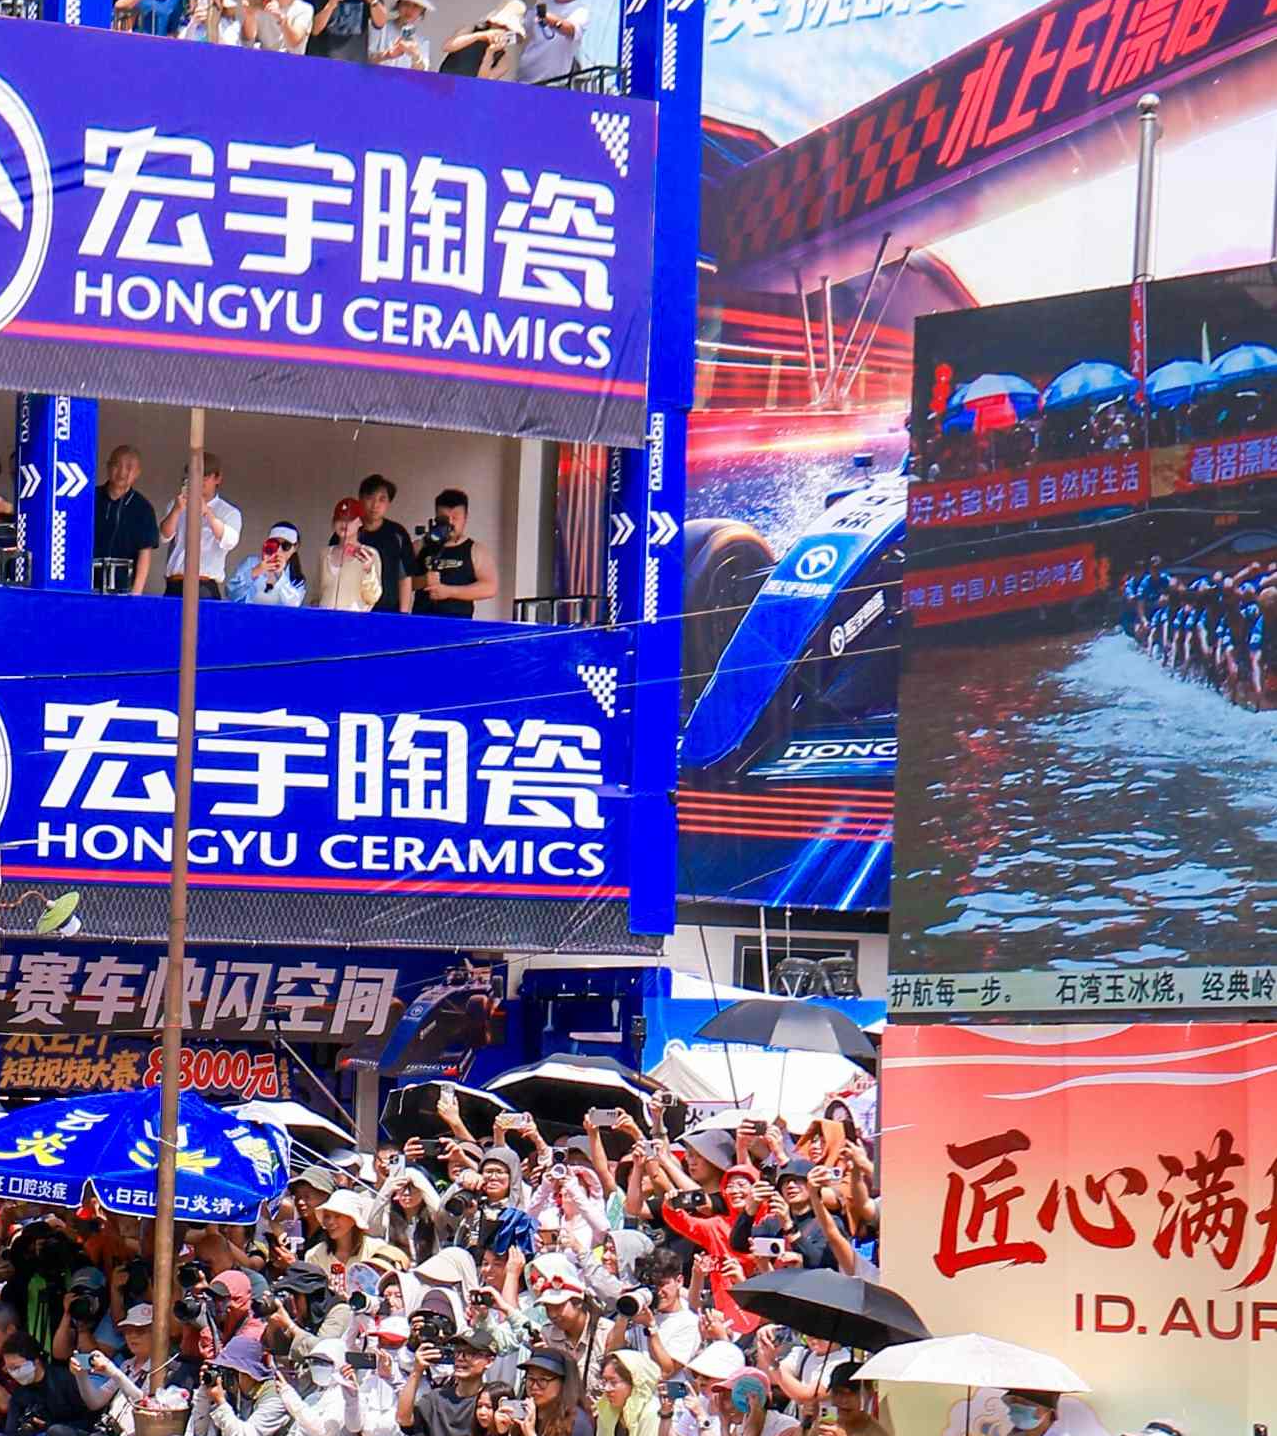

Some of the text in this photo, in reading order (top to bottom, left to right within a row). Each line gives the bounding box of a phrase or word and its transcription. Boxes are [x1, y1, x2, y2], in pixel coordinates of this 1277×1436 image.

[78, 125, 616, 311] 宏宇陶瓷
[74, 271, 613, 370] HONGYU CERAMICS
[648, 412, 666, 492] HONGYU
[41, 700, 606, 832] 宏宇陶瓷
[37, 821, 606, 879] HONGYU CERAMICS
[890, 978, 1013, 1008] 护航每一步。
[0, 1050, 141, 1092] 短视频大赛
[7, 1176, 68, 1200] 口腔炎症
[175, 1195, 236, 1216] 口炎清
[1075, 1293, 1148, 1336] ID.
